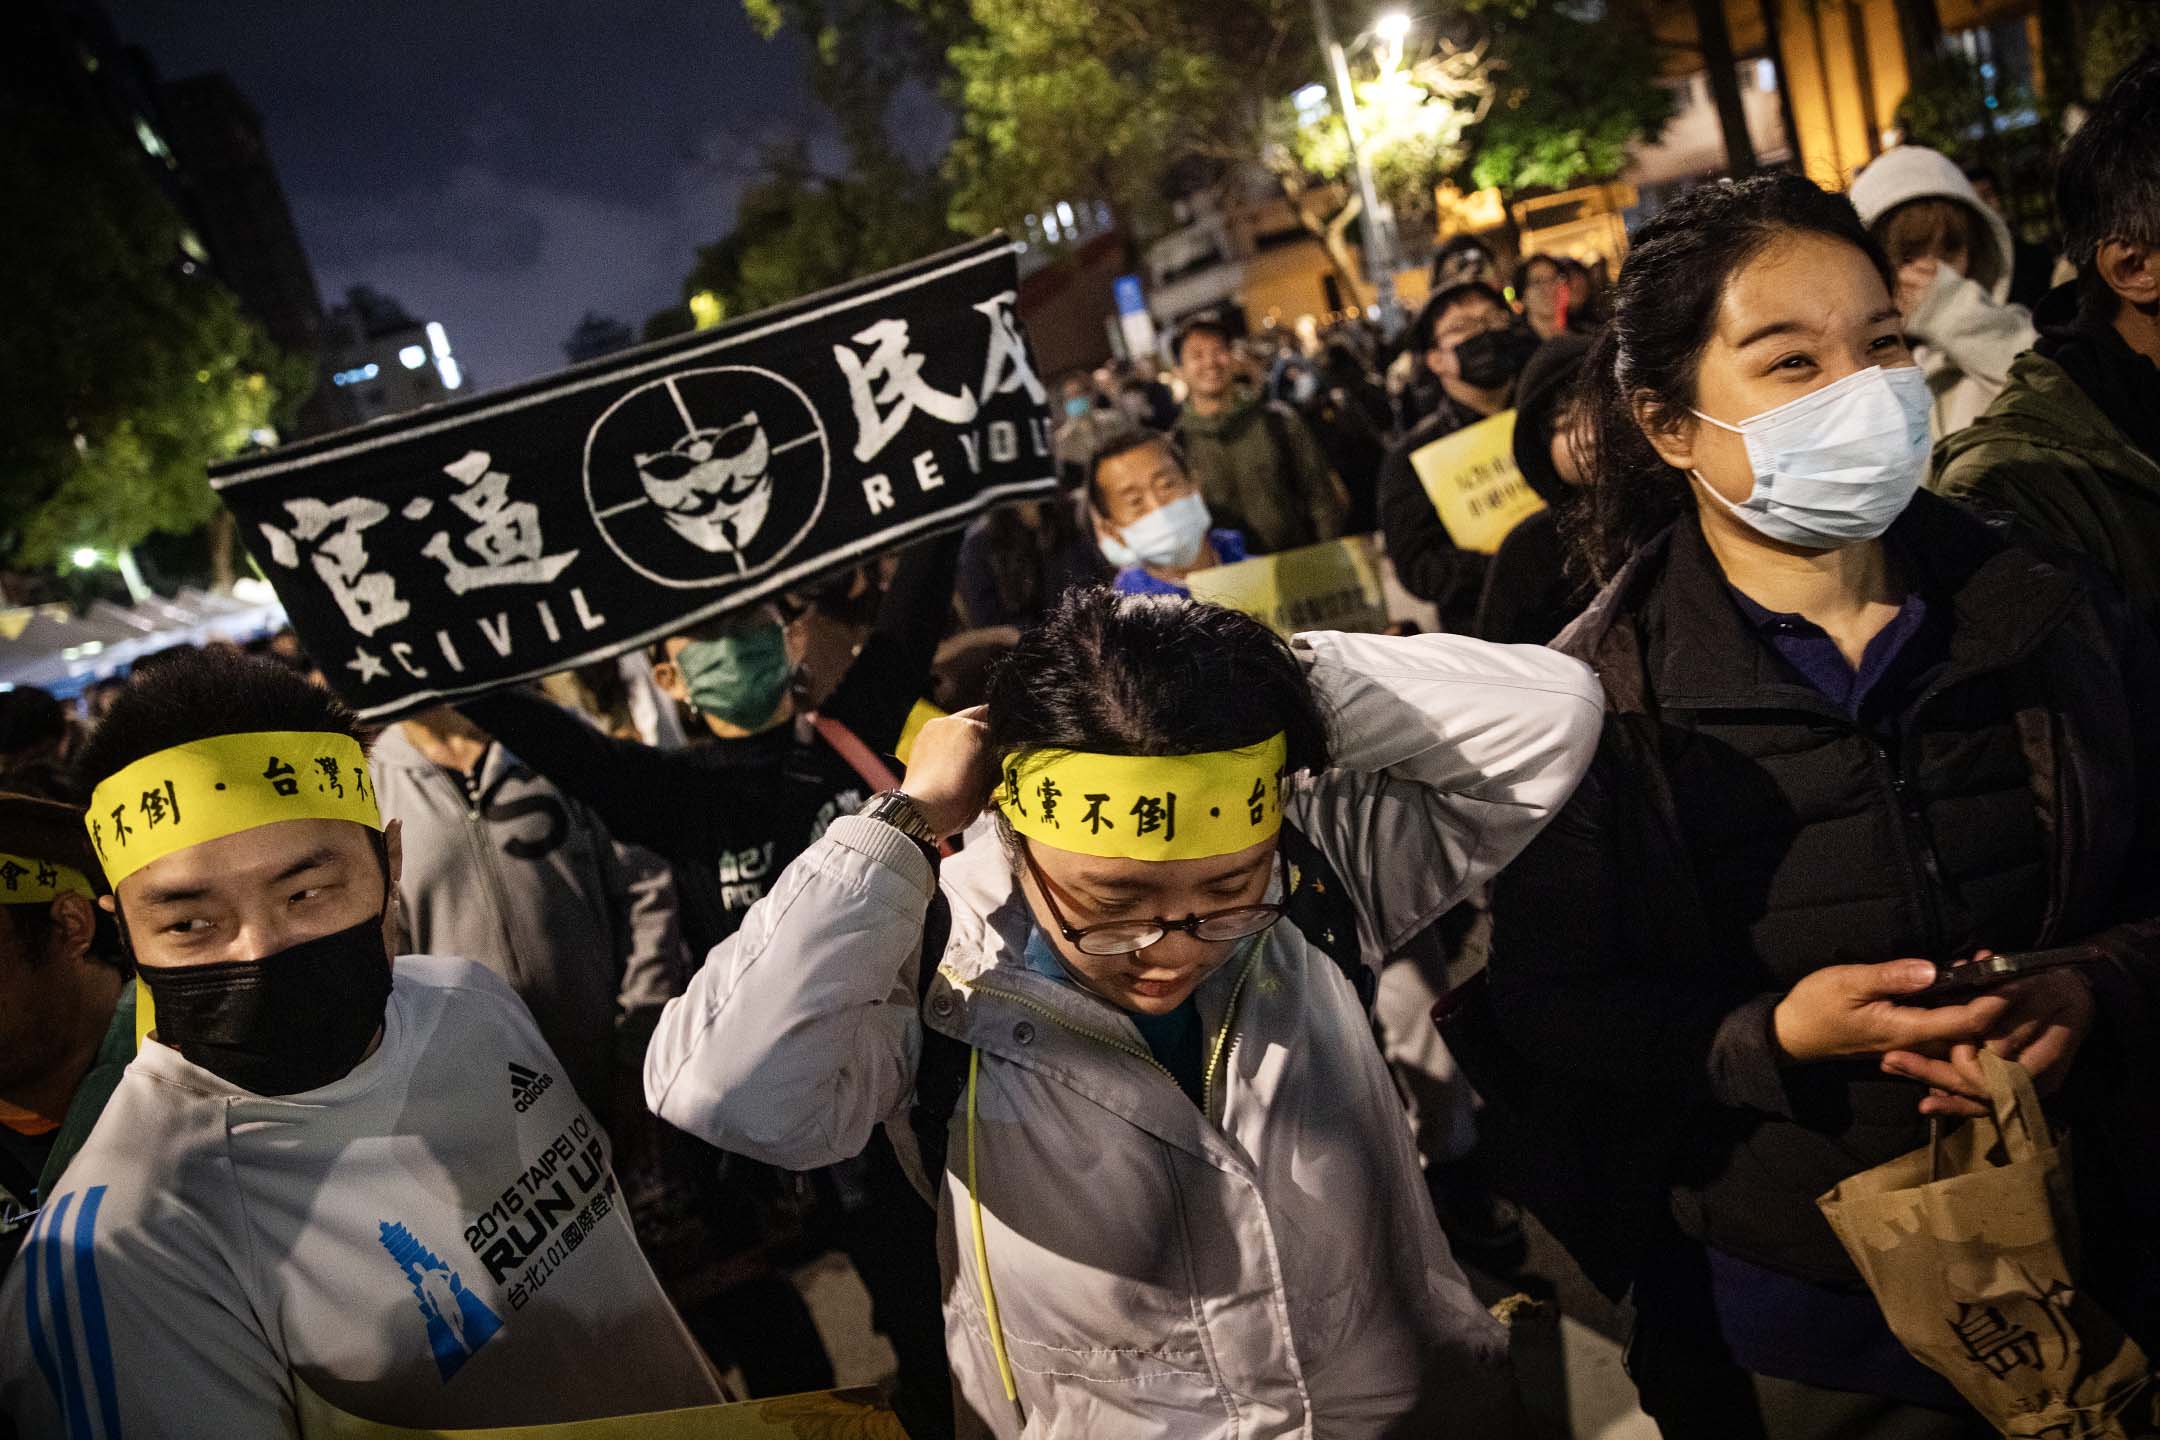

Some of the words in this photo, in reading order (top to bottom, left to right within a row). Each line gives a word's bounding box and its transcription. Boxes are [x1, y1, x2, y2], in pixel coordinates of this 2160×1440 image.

[391, 588, 605, 678] CIVIL
[514, 1072, 554, 1113] adidas
[463, 1190, 525, 1253] 2015
[517, 1135, 576, 1197] TAIPEI
[480, 1182, 576, 1286] RUN
